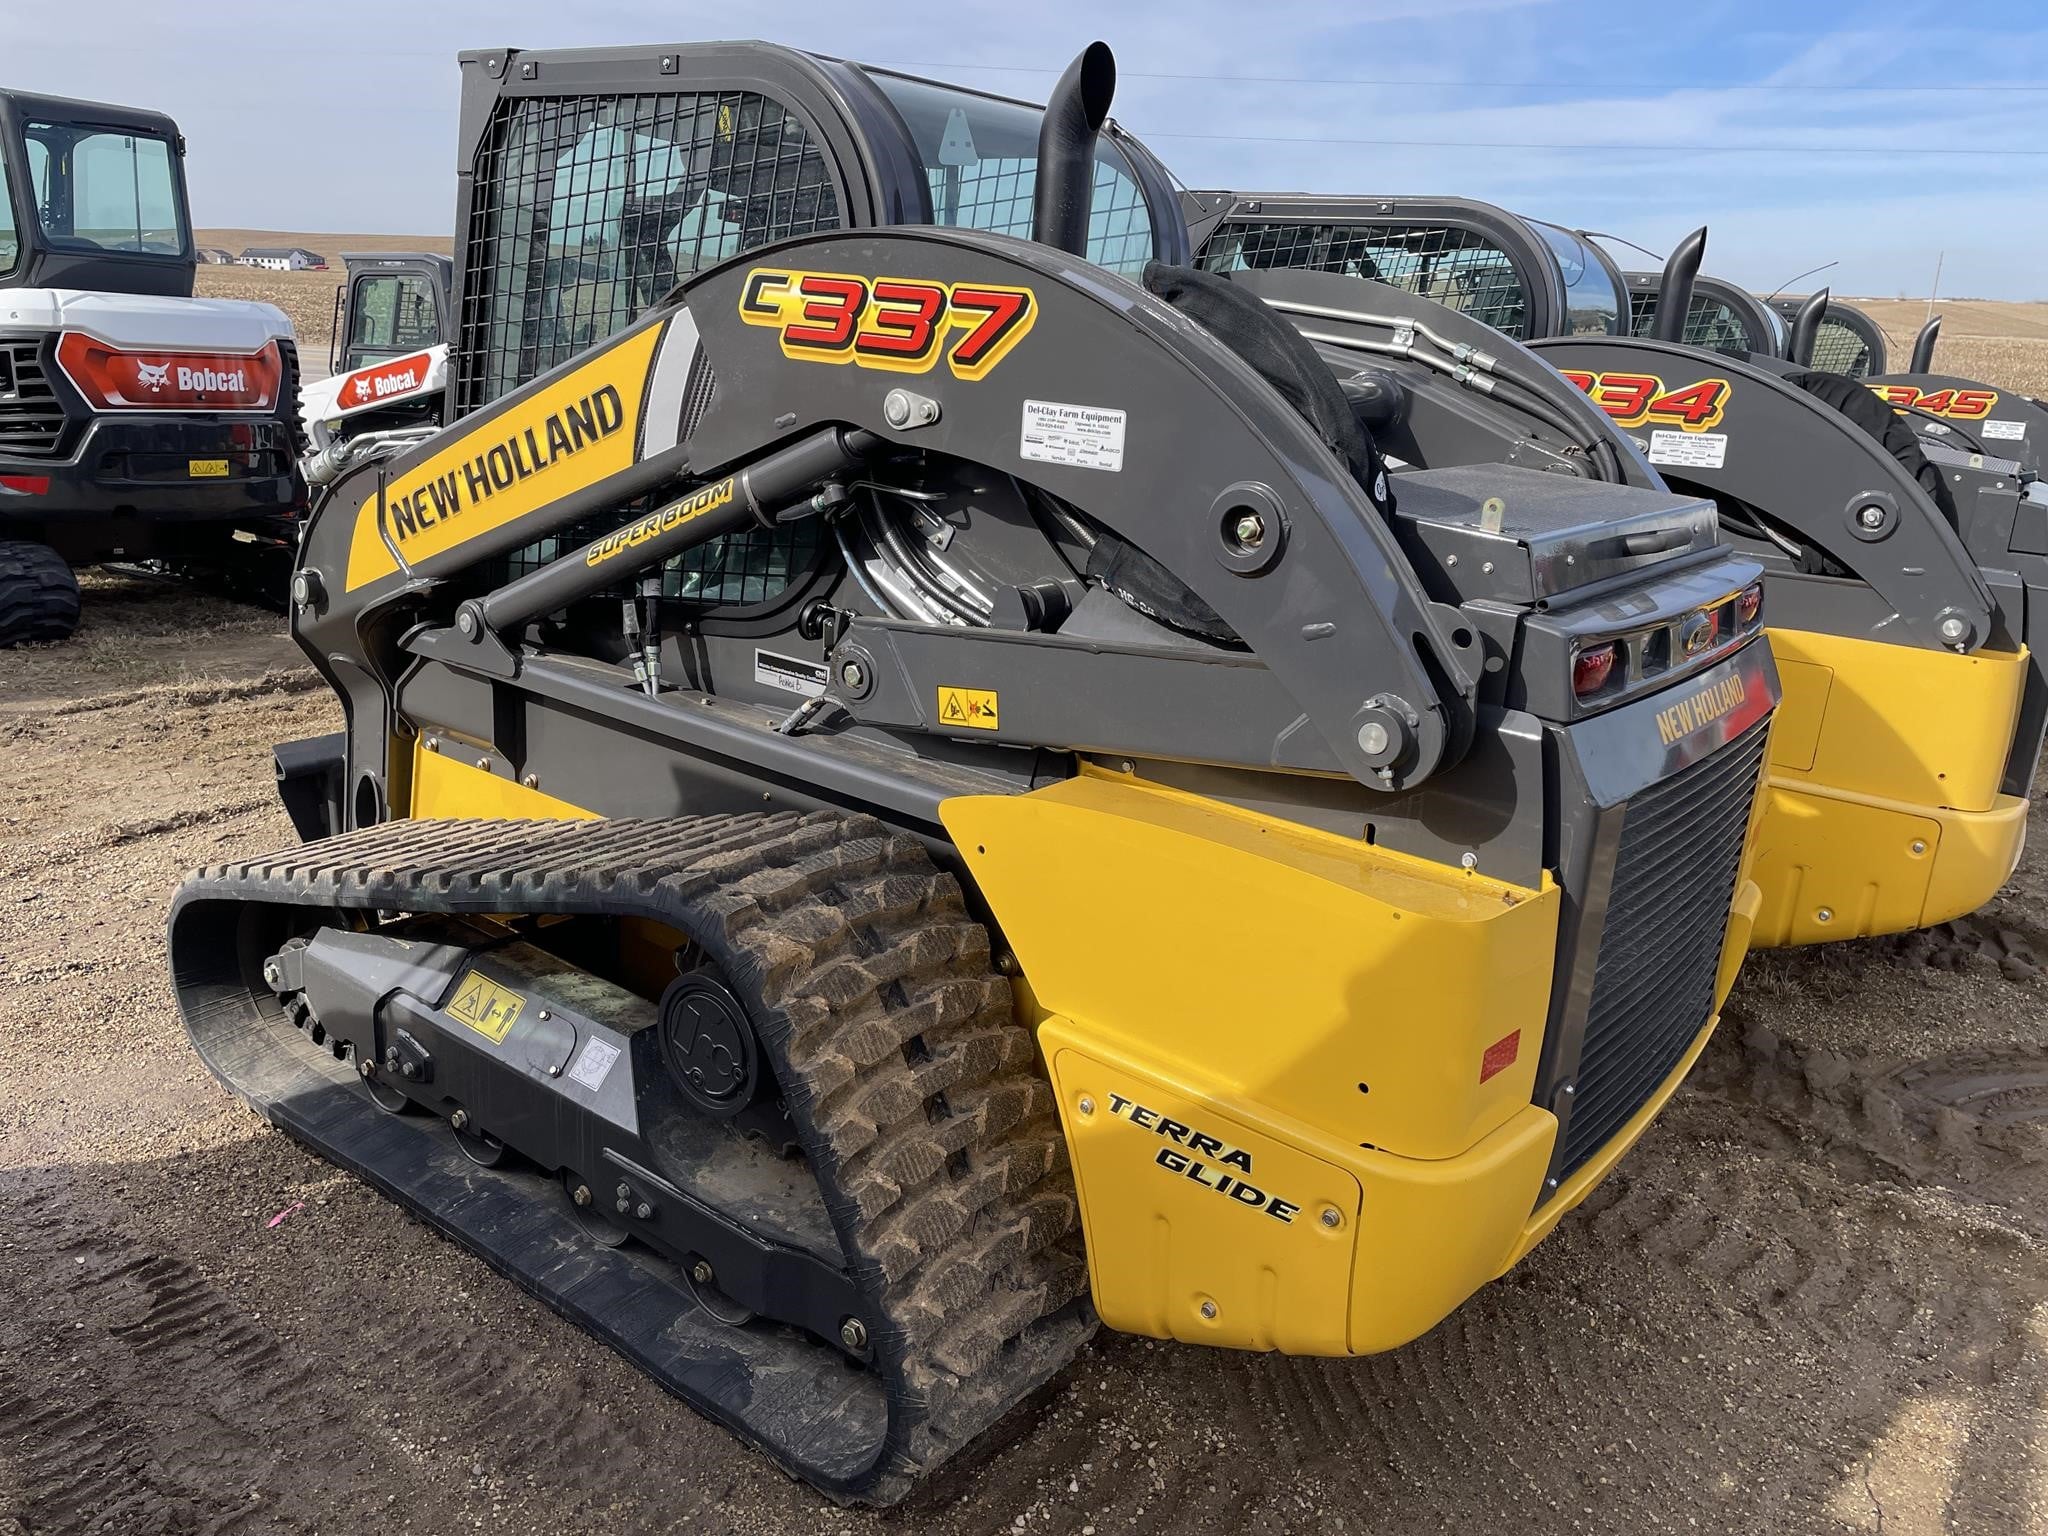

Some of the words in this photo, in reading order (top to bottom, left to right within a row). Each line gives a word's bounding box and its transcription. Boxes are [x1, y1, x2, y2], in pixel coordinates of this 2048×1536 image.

[740, 270, 1035, 377] C337
[177, 366, 246, 392] Bobcat
[374, 367, 417, 398] Bobcat
[1027, 404, 1058, 417] Del-Clay
[1059, 408, 1079, 419] Farm
[1081, 410, 1122, 424] Equipment
[390, 470, 461, 542] NEW
[461, 383, 624, 505] HOLLAND
[587, 512, 661, 567] SUPER
[661, 478, 734, 532] BOOM
[1655, 701, 1694, 745] NEW
[1692, 673, 1745, 727] HOLLAND
[1108, 1091, 1253, 1175] TERRA
[1154, 1147, 1301, 1225] GLIDE
